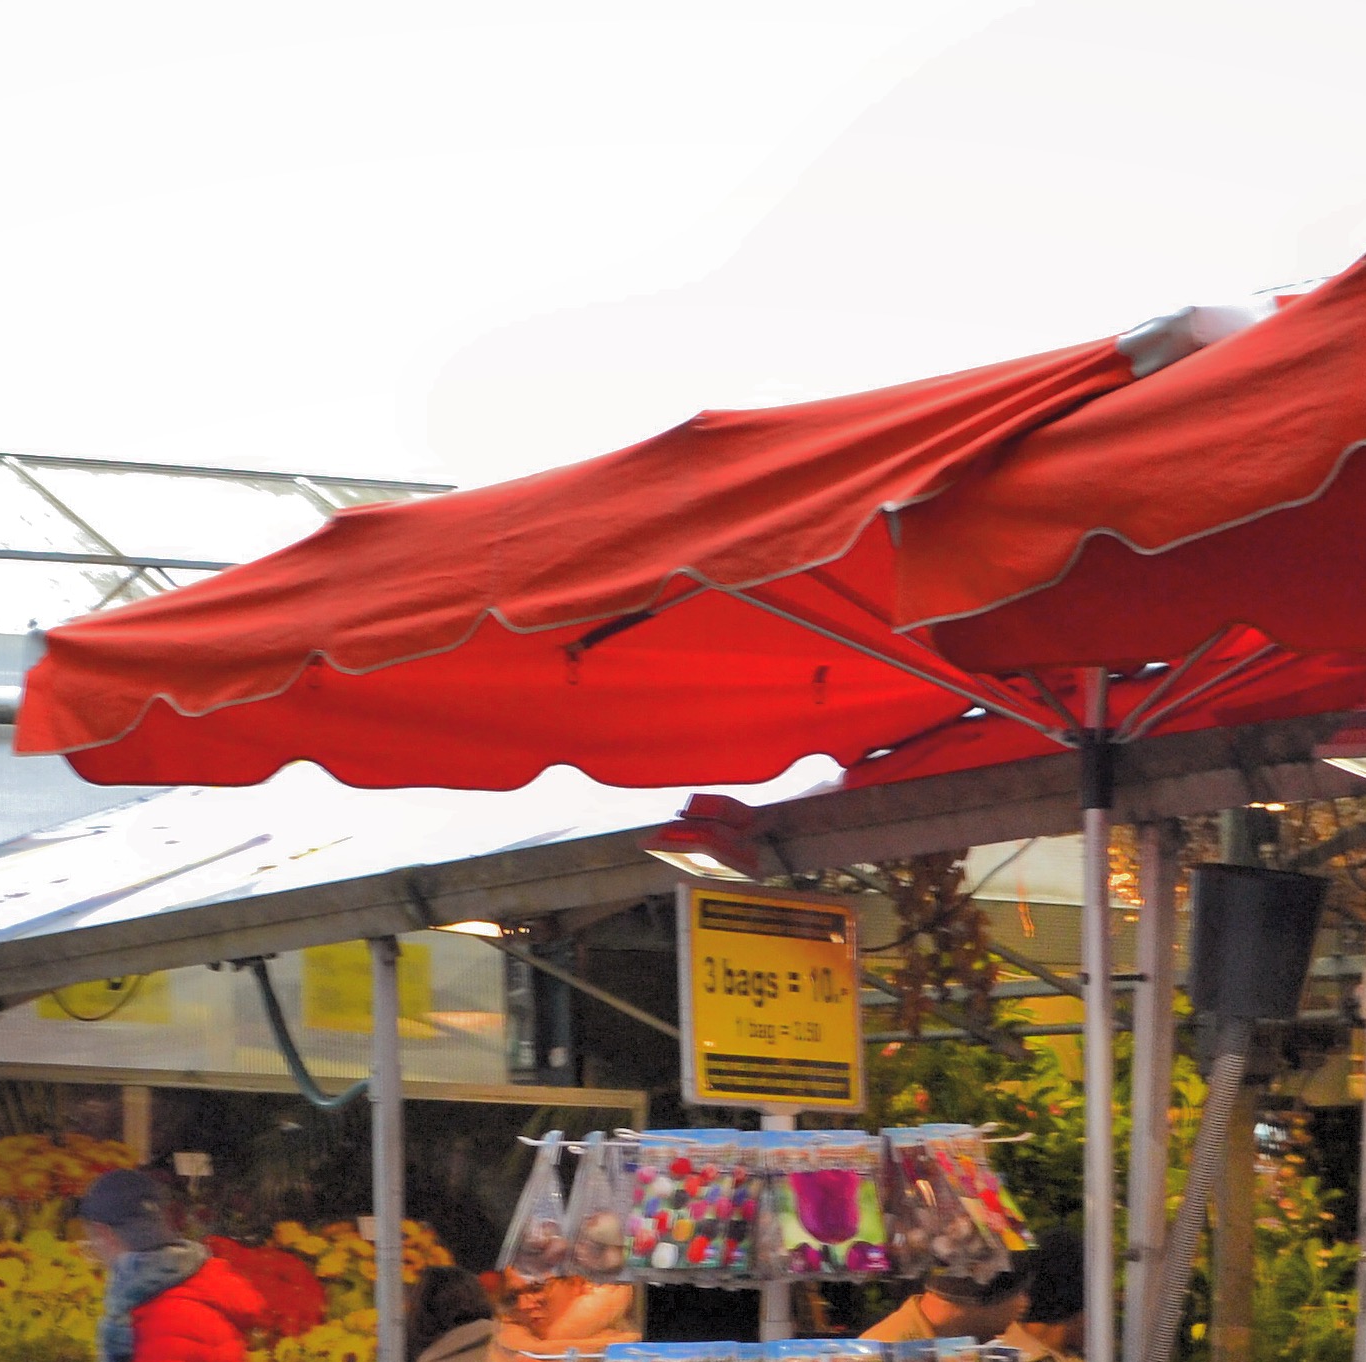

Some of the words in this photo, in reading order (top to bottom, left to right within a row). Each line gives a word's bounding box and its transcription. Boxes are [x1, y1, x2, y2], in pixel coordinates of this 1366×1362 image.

[703, 955, 716, 994] 3
[722, 957, 779, 1008] bags
[787, 971, 800, 993] =
[749, 1018, 776, 1045] bag
